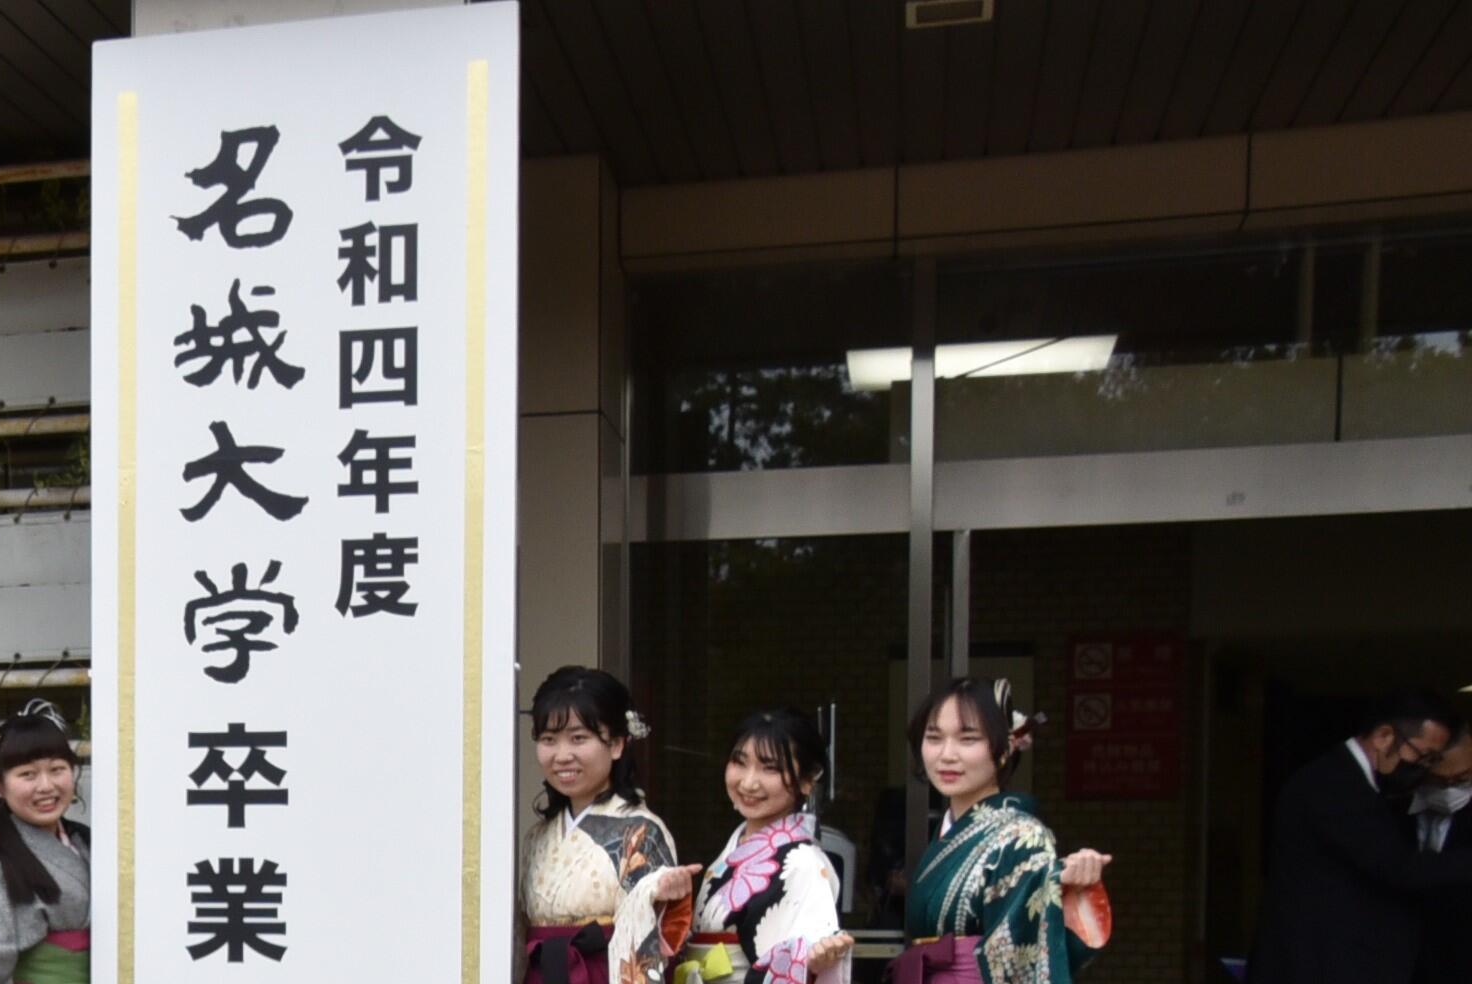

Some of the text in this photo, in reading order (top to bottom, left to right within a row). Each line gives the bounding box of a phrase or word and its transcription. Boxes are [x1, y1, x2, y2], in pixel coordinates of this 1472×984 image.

[335, 115, 422, 618] 令和四年度
